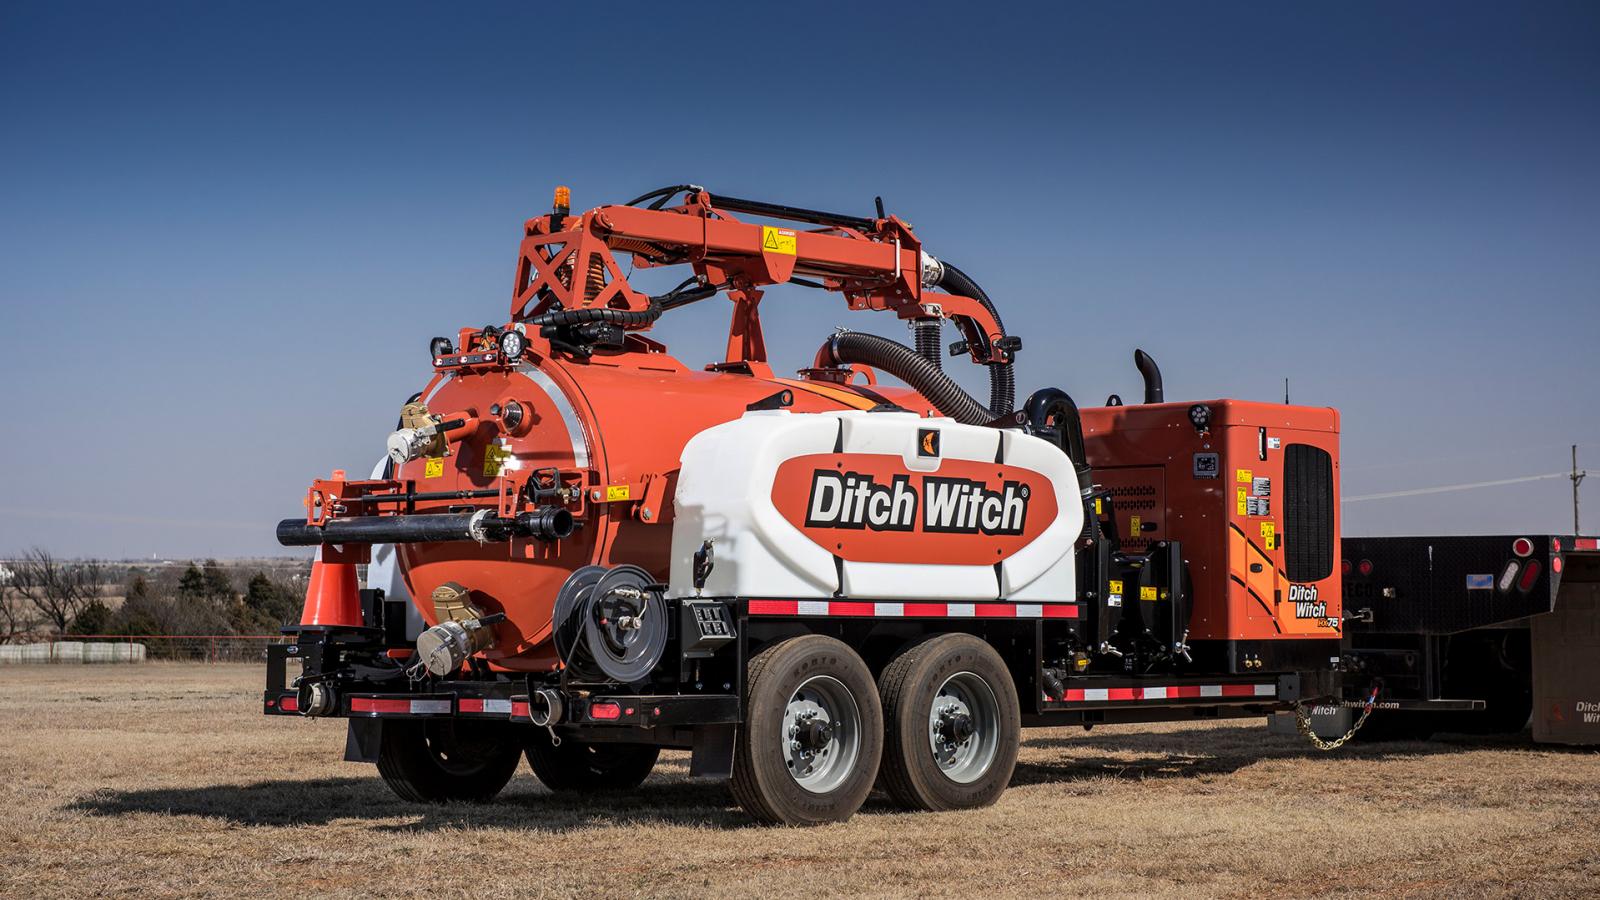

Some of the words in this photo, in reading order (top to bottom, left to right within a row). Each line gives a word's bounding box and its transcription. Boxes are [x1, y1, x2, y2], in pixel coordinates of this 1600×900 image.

[809, 475, 915, 526] Ditch
[1288, 585, 1317, 601] Ditch
[1296, 602, 1326, 618] Witch
